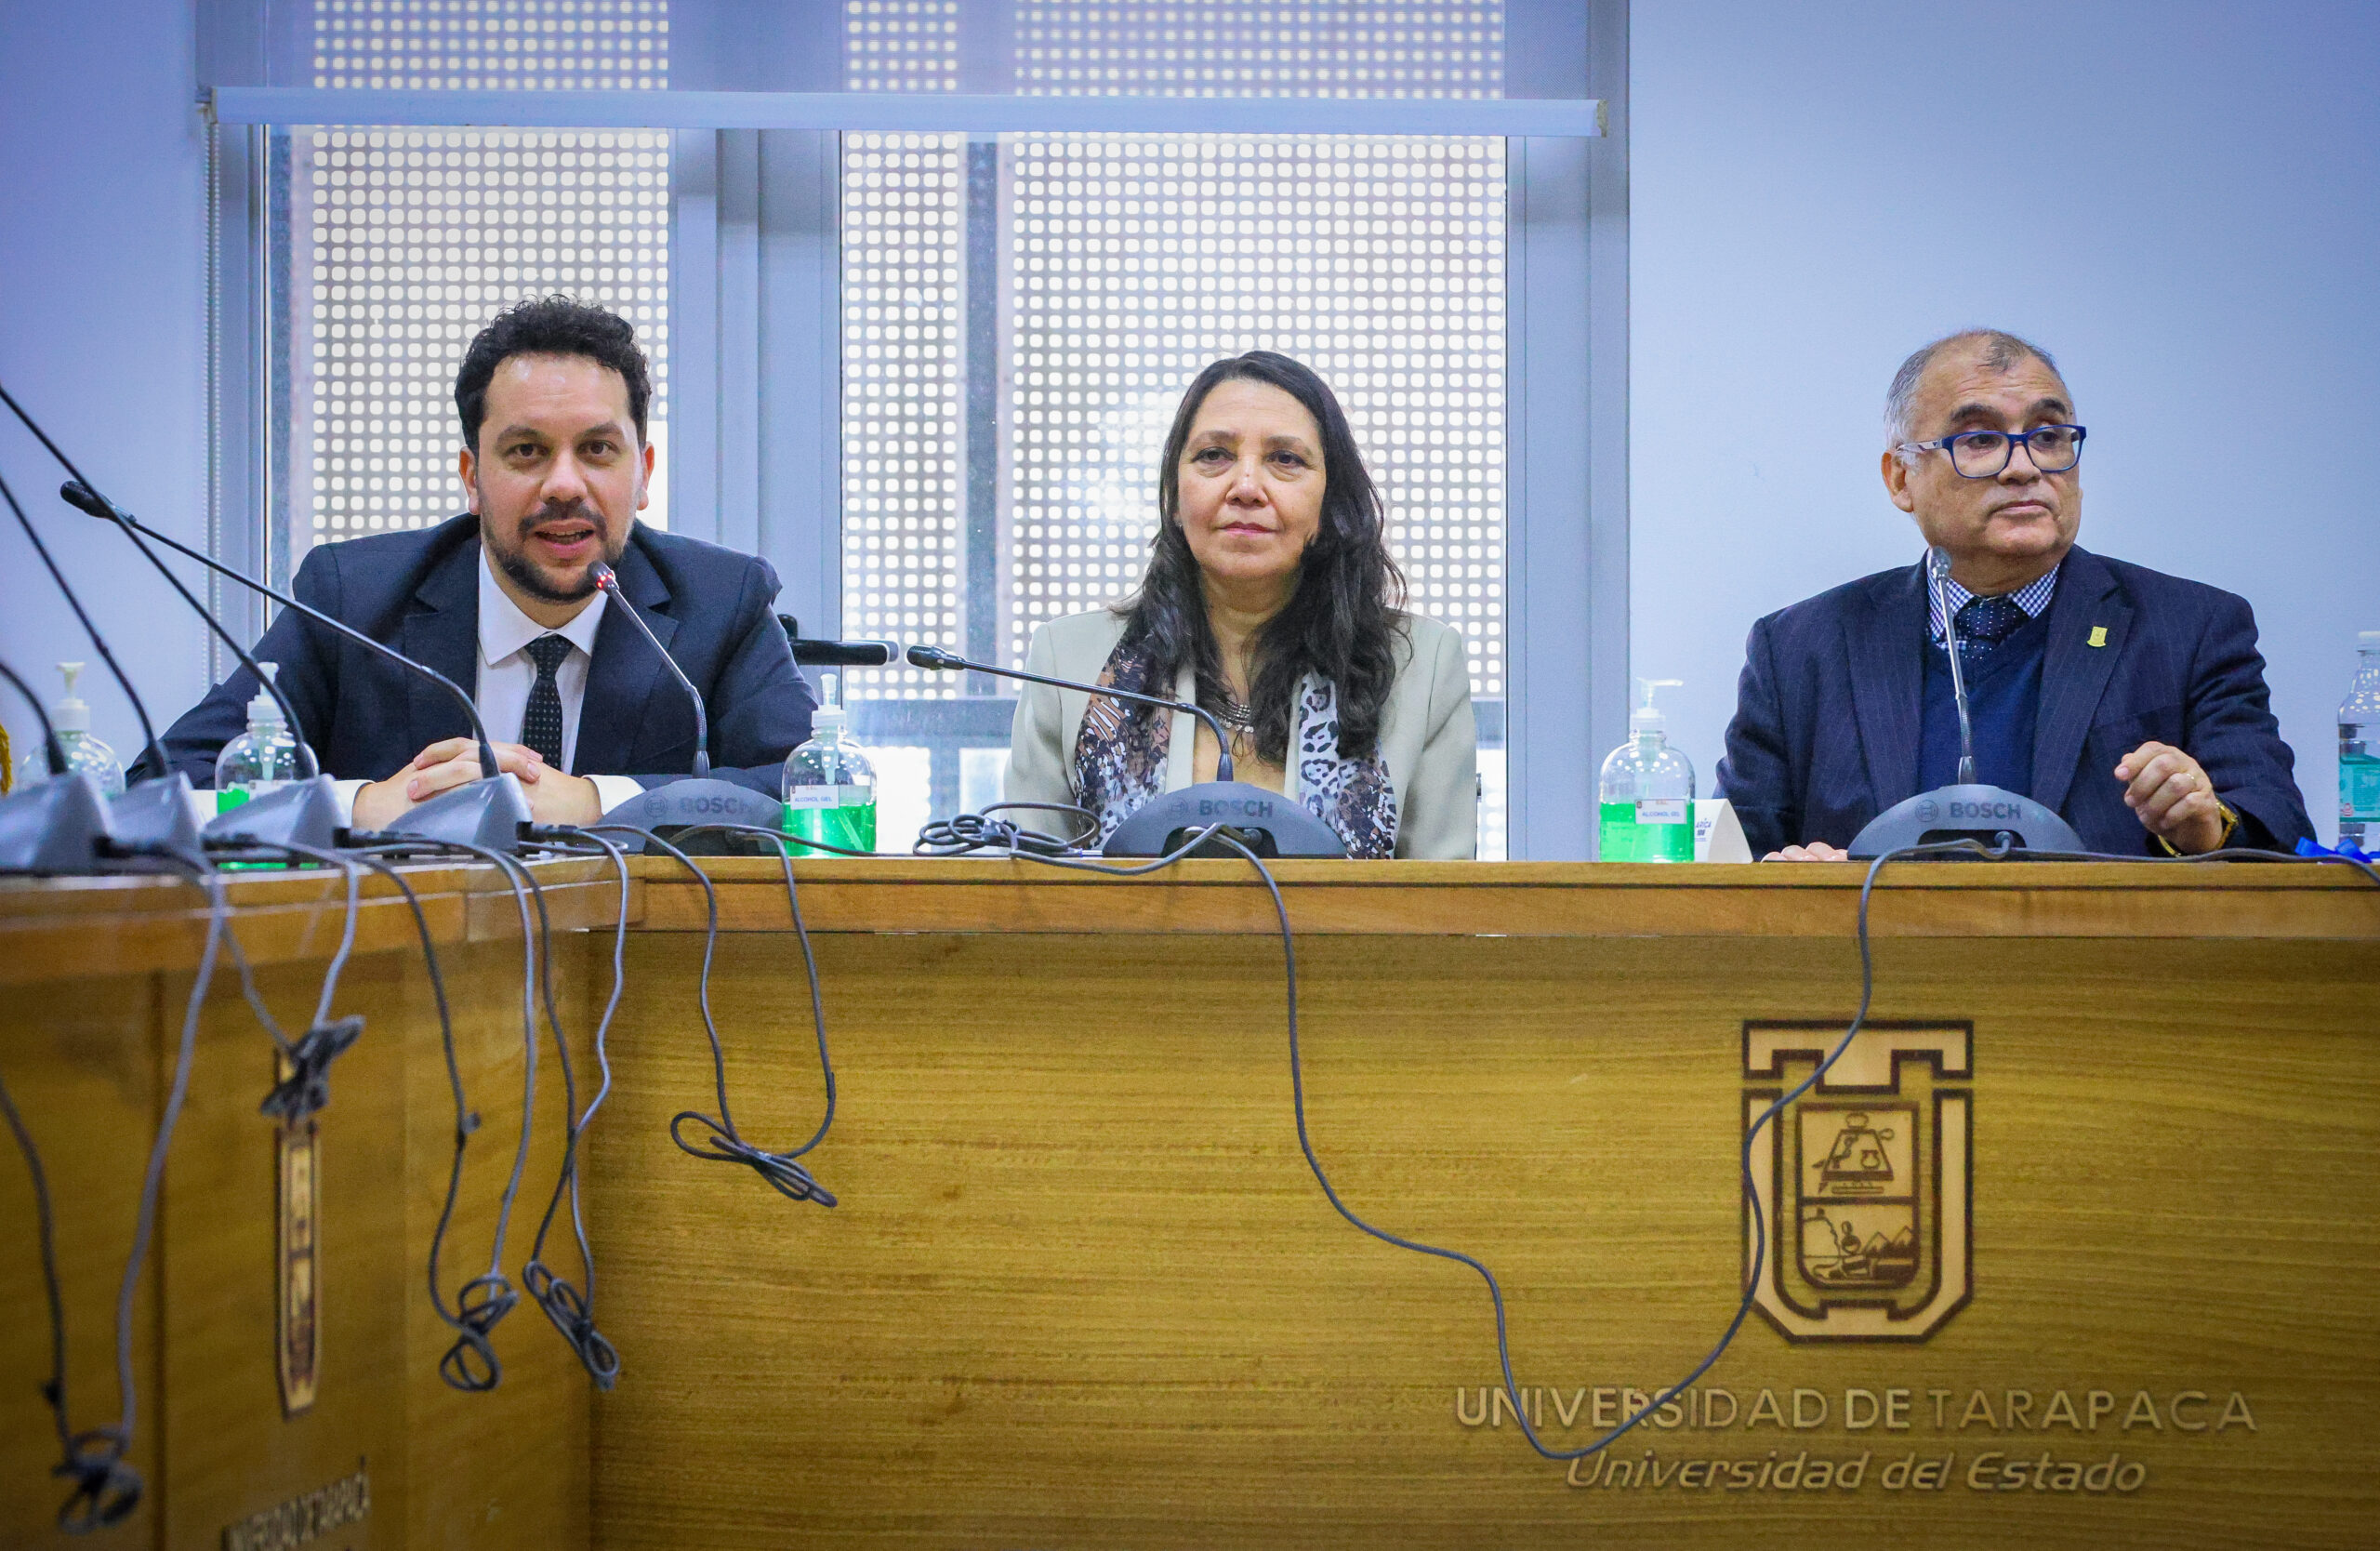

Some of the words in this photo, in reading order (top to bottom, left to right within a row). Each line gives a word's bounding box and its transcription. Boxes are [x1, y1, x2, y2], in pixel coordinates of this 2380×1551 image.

[1199, 800, 1273, 817] BOSCH
[1950, 802, 2021, 819] BOSCH
[1457, 1386, 1829, 1429] UNIVERSIDAD
[1845, 1388, 1911, 1429] DE
[1927, 1389, 2257, 1431] TARAPACA
[1567, 1449, 1871, 1490] Universidad
[1881, 1451, 1953, 1490] del
[1967, 1452, 2146, 1491] Estado
